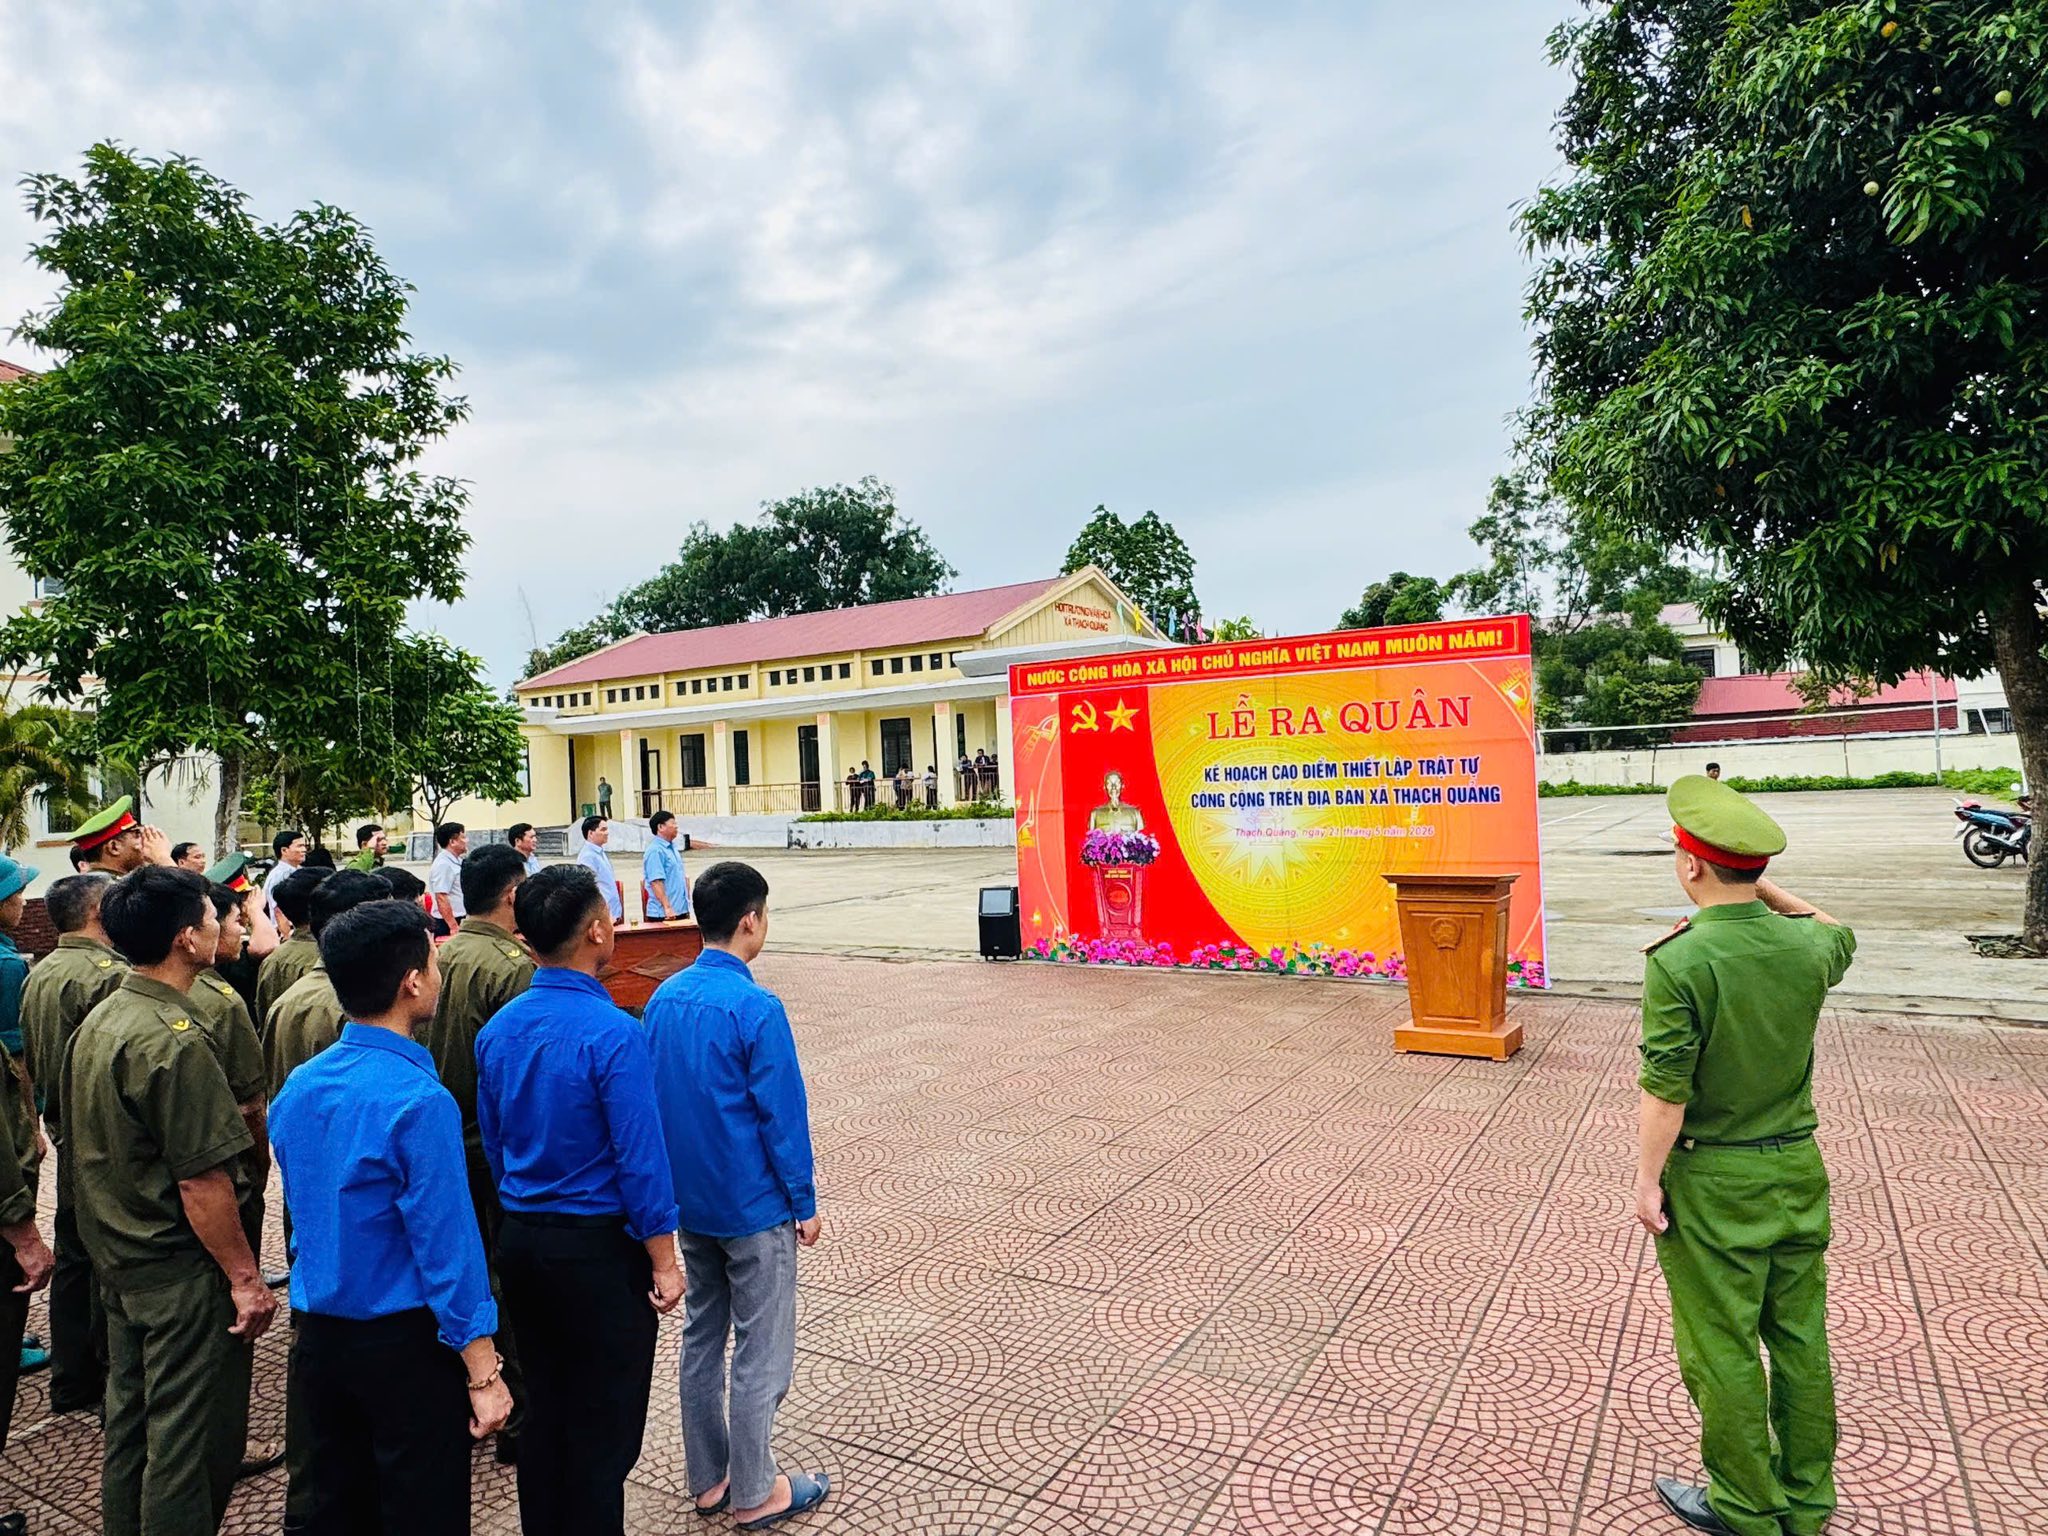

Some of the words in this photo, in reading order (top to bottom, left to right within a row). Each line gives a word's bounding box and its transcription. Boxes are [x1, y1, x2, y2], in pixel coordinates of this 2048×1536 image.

[1027, 668, 1065, 686] NƯỚC
[1069, 665, 1108, 684] CỘNG
[1112, 660, 1142, 678] HÒA
[1146, 657, 1166, 675] XÃ
[1171, 655, 1197, 677] HỘI
[1202, 649, 1235, 670] CHỦ
[1239, 641, 1291, 667] NGHĨA
[1295, 643, 1333, 664] VIỆT
[1337, 640, 1380, 659] NAM
[1385, 634, 1443, 655] MUÔN
[1449, 629, 1503, 649] NĂM!
[1207, 693, 1256, 739] LỄ
[1268, 706, 1326, 737] RA
[1339, 688, 1471, 734] QUÂN
[1204, 763, 1220, 782] KẾ
[1224, 765, 1267, 784] HOẠCH
[1272, 764, 1298, 780] CAO
[1302, 757, 1337, 779] ĐIỂM
[1342, 756, 1380, 778] THIẾT
[1385, 757, 1412, 780] LẬP
[1417, 756, 1454, 779] TRẬT
[1459, 756, 1480, 778] TỰ
[1191, 790, 1225, 808] CÔNG
[1230, 789, 1265, 811] CỘNG
[1269, 788, 1303, 806] TRÊN
[1307, 790, 1331, 809] ĐỊA
[1335, 786, 1364, 805] BÀN
[1369, 785, 1389, 805] XÃ
[1393, 787, 1441, 807] THẠCH
[1447, 781, 1501, 805] QUẢNG
[1374, 826, 1381, 836] 5
[1409, 826, 1434, 836] 2026
